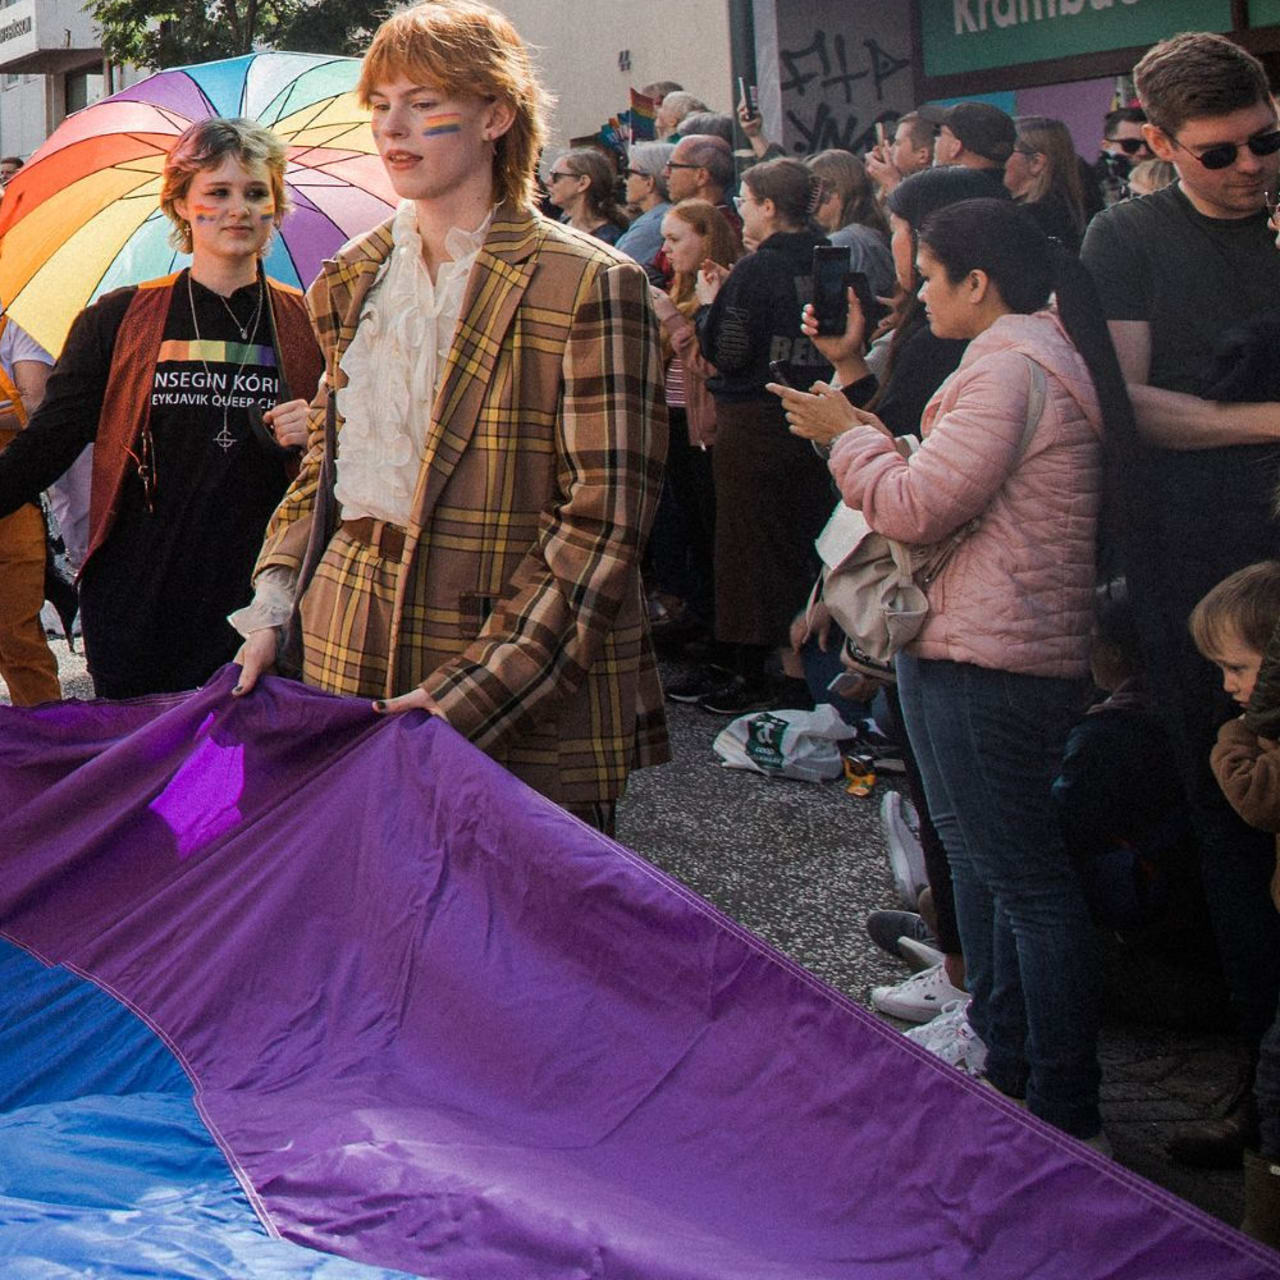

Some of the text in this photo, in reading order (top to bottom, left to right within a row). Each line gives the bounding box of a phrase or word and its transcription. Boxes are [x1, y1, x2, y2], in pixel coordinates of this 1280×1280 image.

[154, 371, 279, 394] NSEGIN KÓRI
[152, 392, 209, 406] EYKJAVIK
